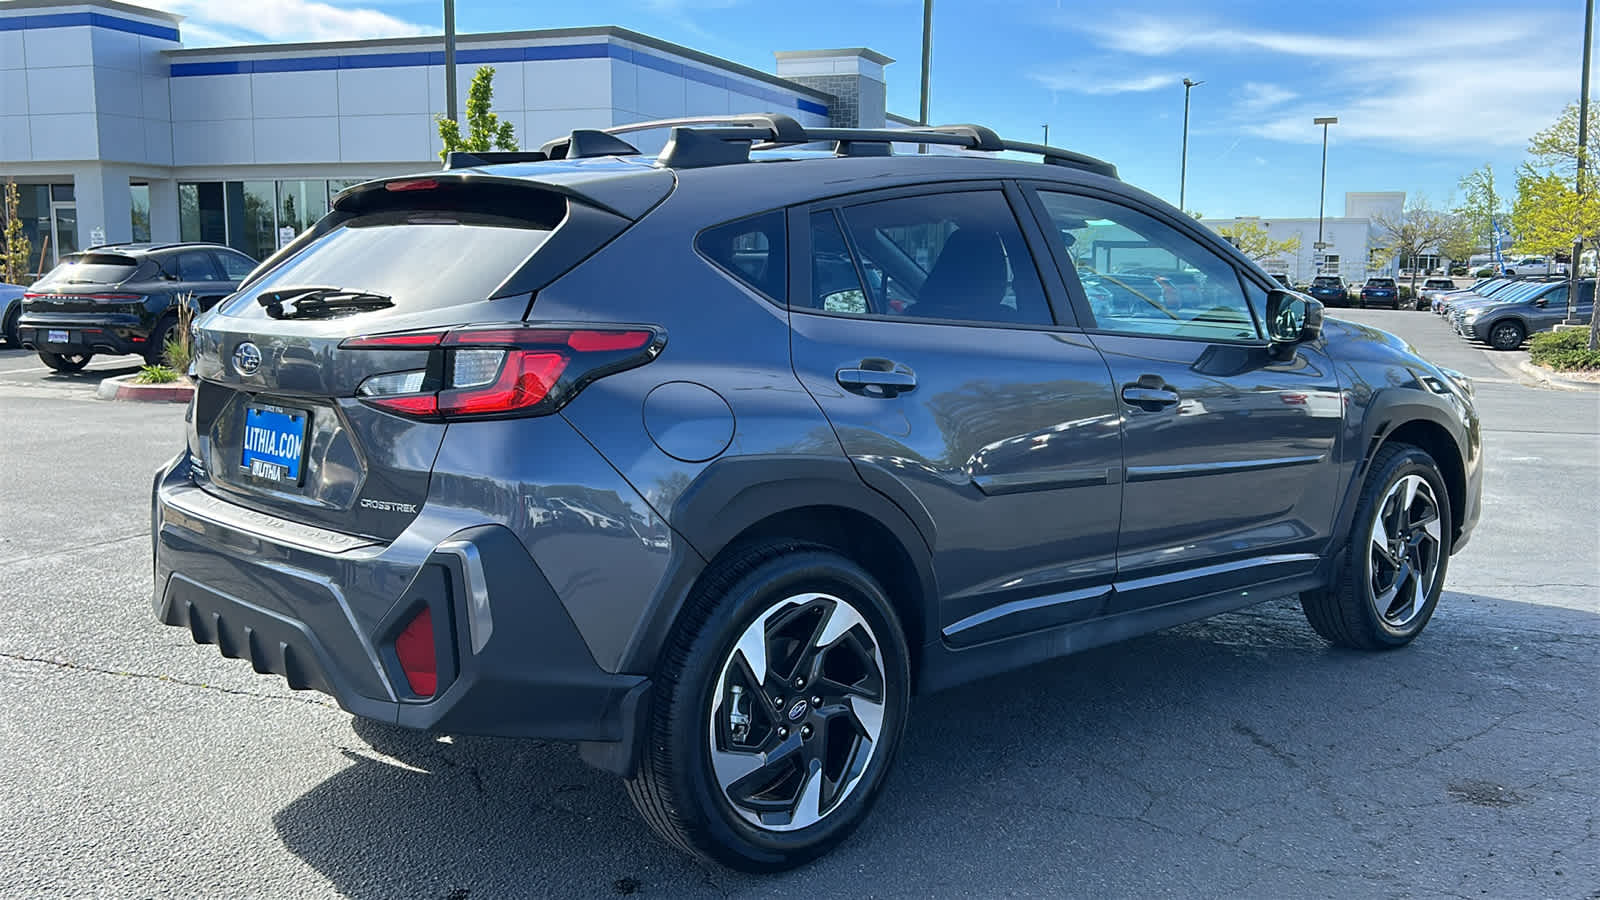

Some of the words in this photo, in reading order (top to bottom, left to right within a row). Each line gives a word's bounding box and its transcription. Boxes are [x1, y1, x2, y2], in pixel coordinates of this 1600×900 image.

[244, 425, 302, 460] LITHIA.COM
[258, 462, 281, 482] LITHIA
[360, 498, 417, 514] CROSSTREK
